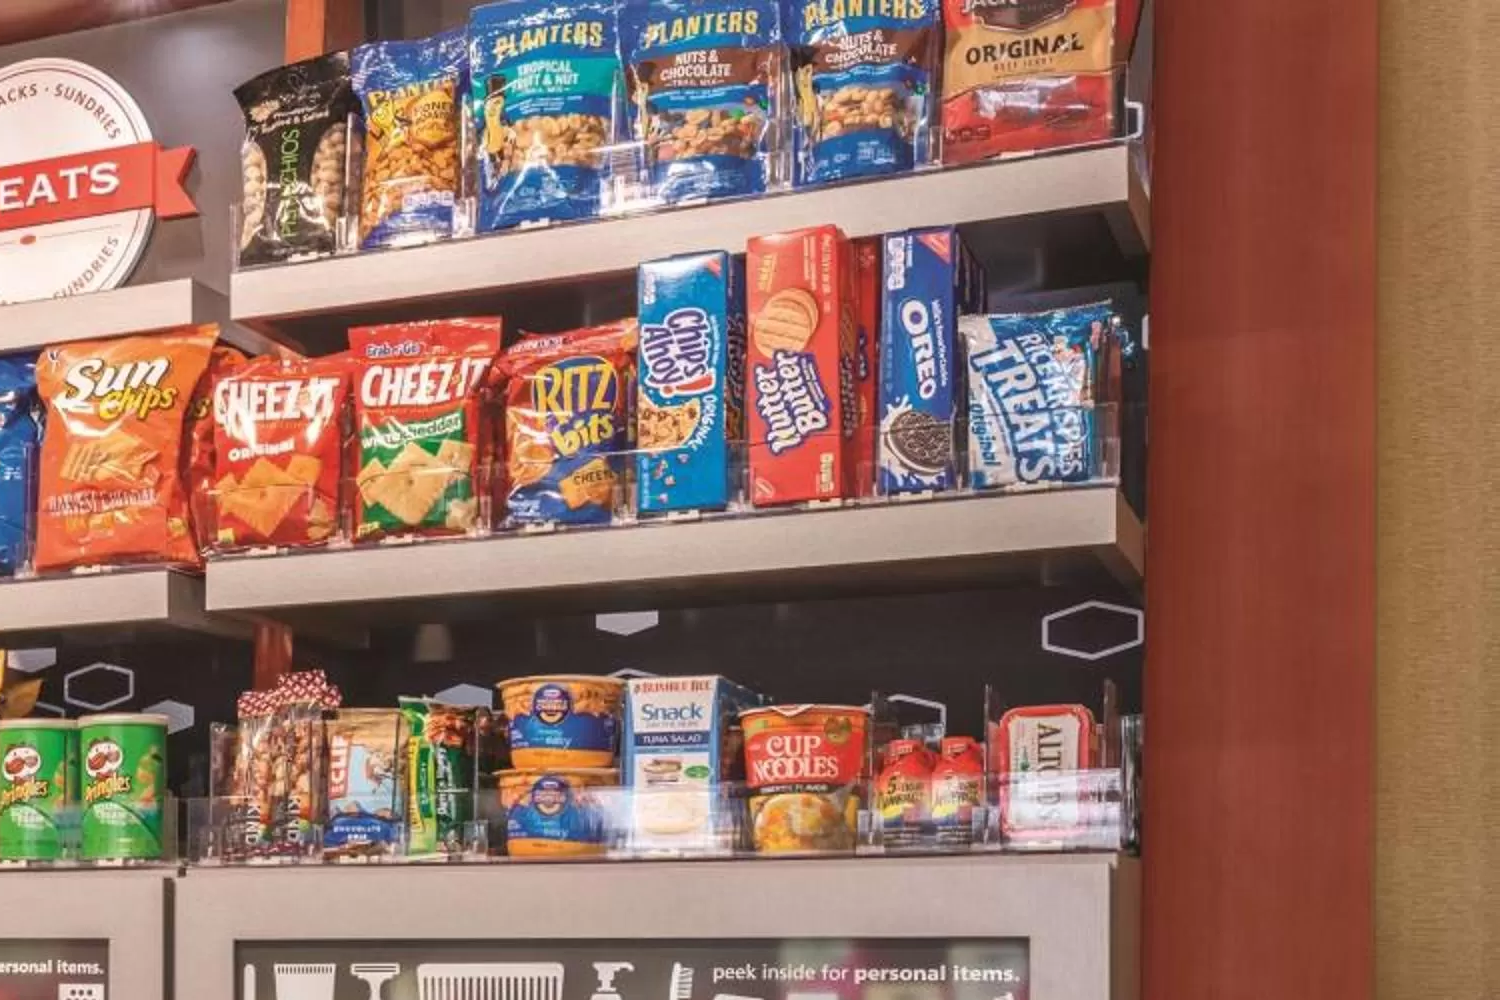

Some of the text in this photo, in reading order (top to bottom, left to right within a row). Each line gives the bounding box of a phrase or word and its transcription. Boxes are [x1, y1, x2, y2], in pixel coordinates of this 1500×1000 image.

[492, 21, 603, 68] PLANTERS
[644, 10, 759, 49] PLANTERS
[675, 50, 718, 65] NUTS &
[966, 33, 1085, 65] ORIGINAL
[660, 64, 732, 81] CHOCOLATE
[54, 82, 121, 140] SUNDRIES
[901, 299, 936, 400] OREO
[64, 357, 169, 400] Sun
[536, 364, 612, 423] RITZ
[971, 338, 1056, 483] TREATS
[641, 702, 704, 721] Snack
[766, 735, 822, 757] CUP
[753, 756, 839, 785] NOODLES
[57, 960, 105, 975] items.
[713, 964, 1021, 984] peek inside for personal items.
